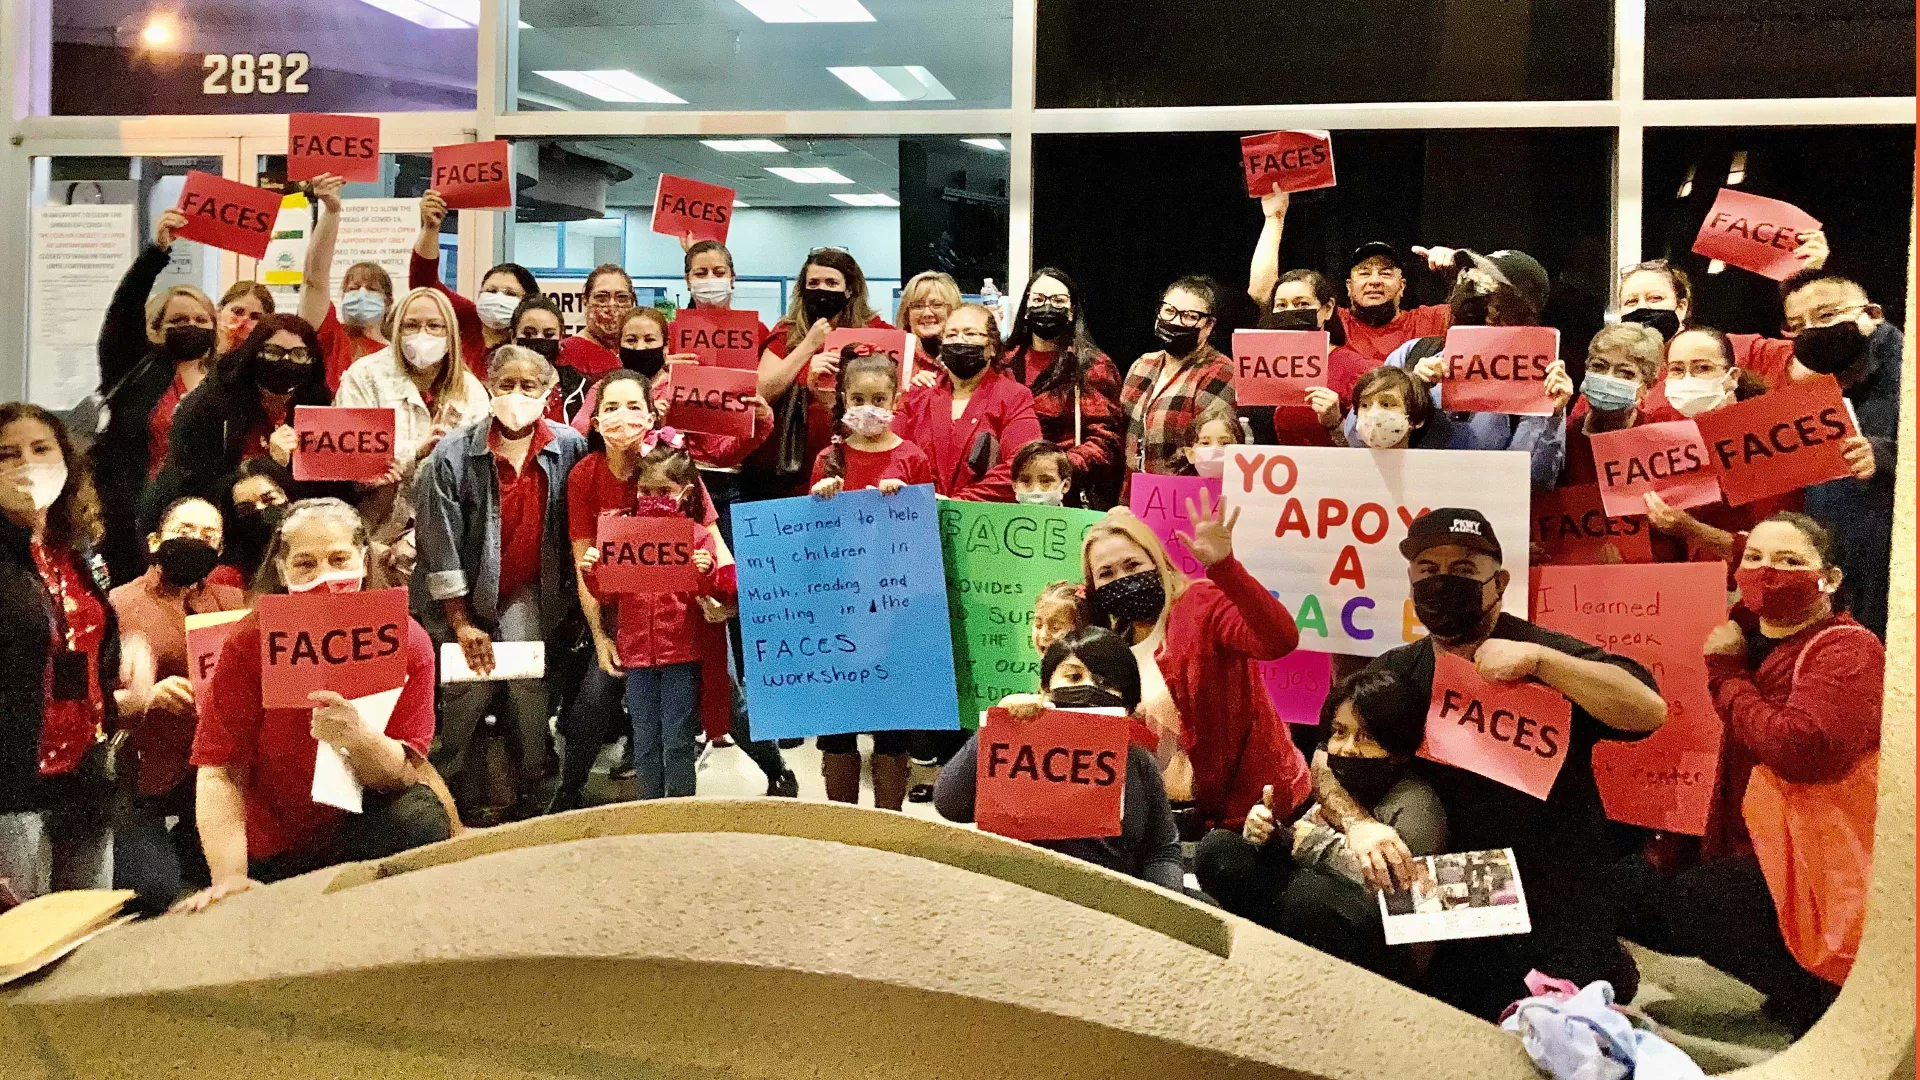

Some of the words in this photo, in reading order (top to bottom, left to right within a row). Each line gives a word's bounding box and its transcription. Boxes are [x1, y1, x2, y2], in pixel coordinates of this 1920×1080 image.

[203, 53, 310, 94] 2832
[292, 135, 374, 159] FACES
[1250, 144, 1326, 175] FACES
[436, 162, 503, 186] FACES
[182, 191, 271, 233] FACES
[660, 193, 728, 223] FACES
[680, 329, 754, 350] FACES
[1238, 355, 1321, 378] FACES
[1450, 354, 1549, 381] FACES
[673, 386, 749, 413] FACES
[298, 430, 390, 453] FACES
[1714, 407, 1848, 470] FACES
[1234, 452, 1298, 494] YO
[1604, 444, 1701, 487] FACES
[744, 517, 760, 538] I
[773, 513, 841, 536] learned
[858, 509, 875, 525] to
[939, 509, 1094, 561] FACE
[1539, 509, 1641, 542] FACES
[602, 540, 690, 566] FACES
[747, 556, 777, 574] my
[792, 545, 867, 562] children
[891, 542, 909, 554] in
[1328, 545, 1366, 590] A
[808, 578, 860, 594] reading
[879, 575, 907, 588] and
[752, 607, 815, 625] writing
[840, 605, 855, 615] in
[882, 595, 910, 610] the
[1272, 590, 1430, 643] ACE
[1538, 587, 1554, 614] I
[1574, 584, 1660, 618] learned
[268, 624, 400, 666] FACES
[756, 634, 857, 663] FACES
[995, 660, 1040, 676] OUR
[1438, 688, 1560, 758] FACES
[988, 742, 1117, 786] FACES
